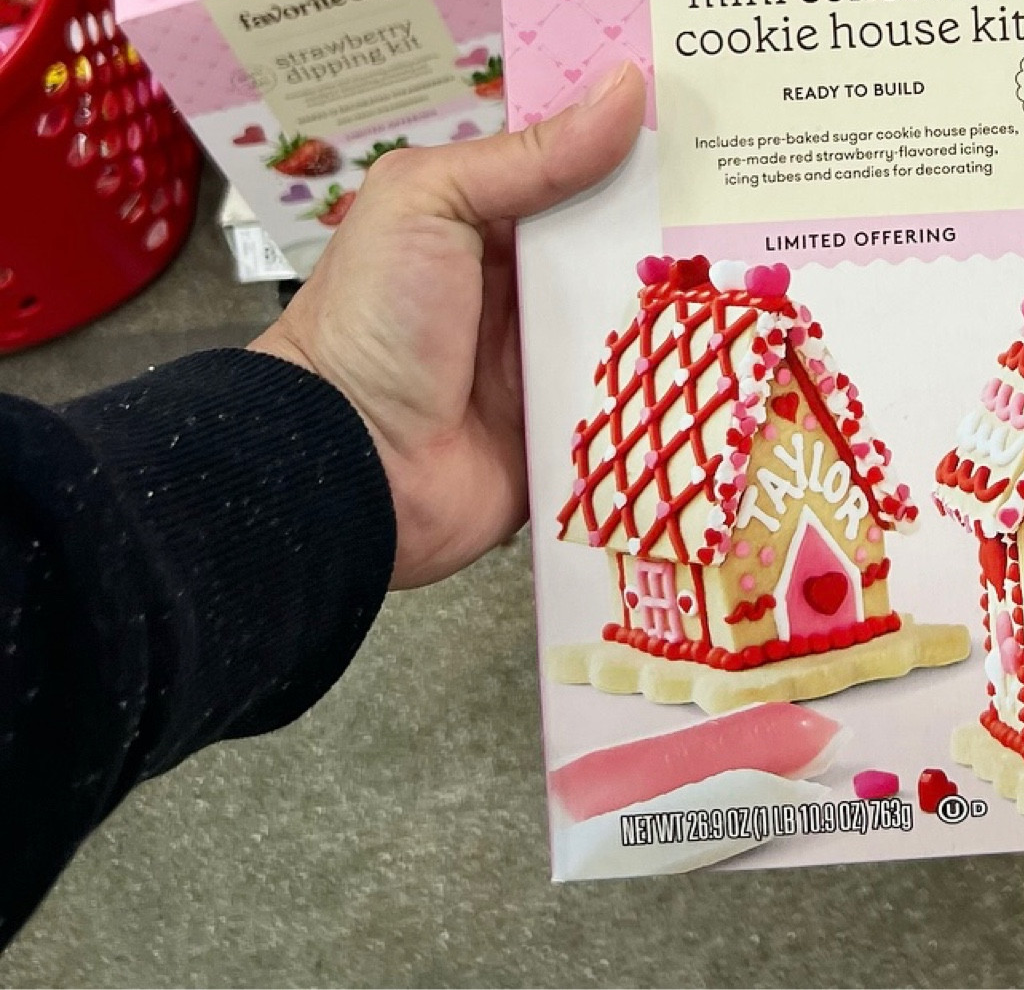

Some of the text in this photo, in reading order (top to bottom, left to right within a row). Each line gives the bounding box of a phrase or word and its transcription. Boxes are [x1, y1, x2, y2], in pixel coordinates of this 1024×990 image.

[275, 19, 413, 69] strawberry
[675, 16, 819, 56] cookie
[829, 12, 961, 49] house
[286, 47, 387, 84] dipping
[386, 33, 423, 57] kit
[782, 81, 925, 101] READY TO BUILD
[695, 122, 1020, 150] Includes pre-baked sugar cookie house pieces,
[717, 142, 999, 170] pre-made red strawberry-flavored icing,
[725, 161, 993, 188] icing tubes and candies for decorating
[765, 227, 957, 251] LIMITED OFFERING
[736, 433, 870, 540] TAYLOR
[620, 798, 914, 846] NET WT 26.9 OZ (1 LB 10.9 OZ) 763g
[971, 800, 988, 817] D
